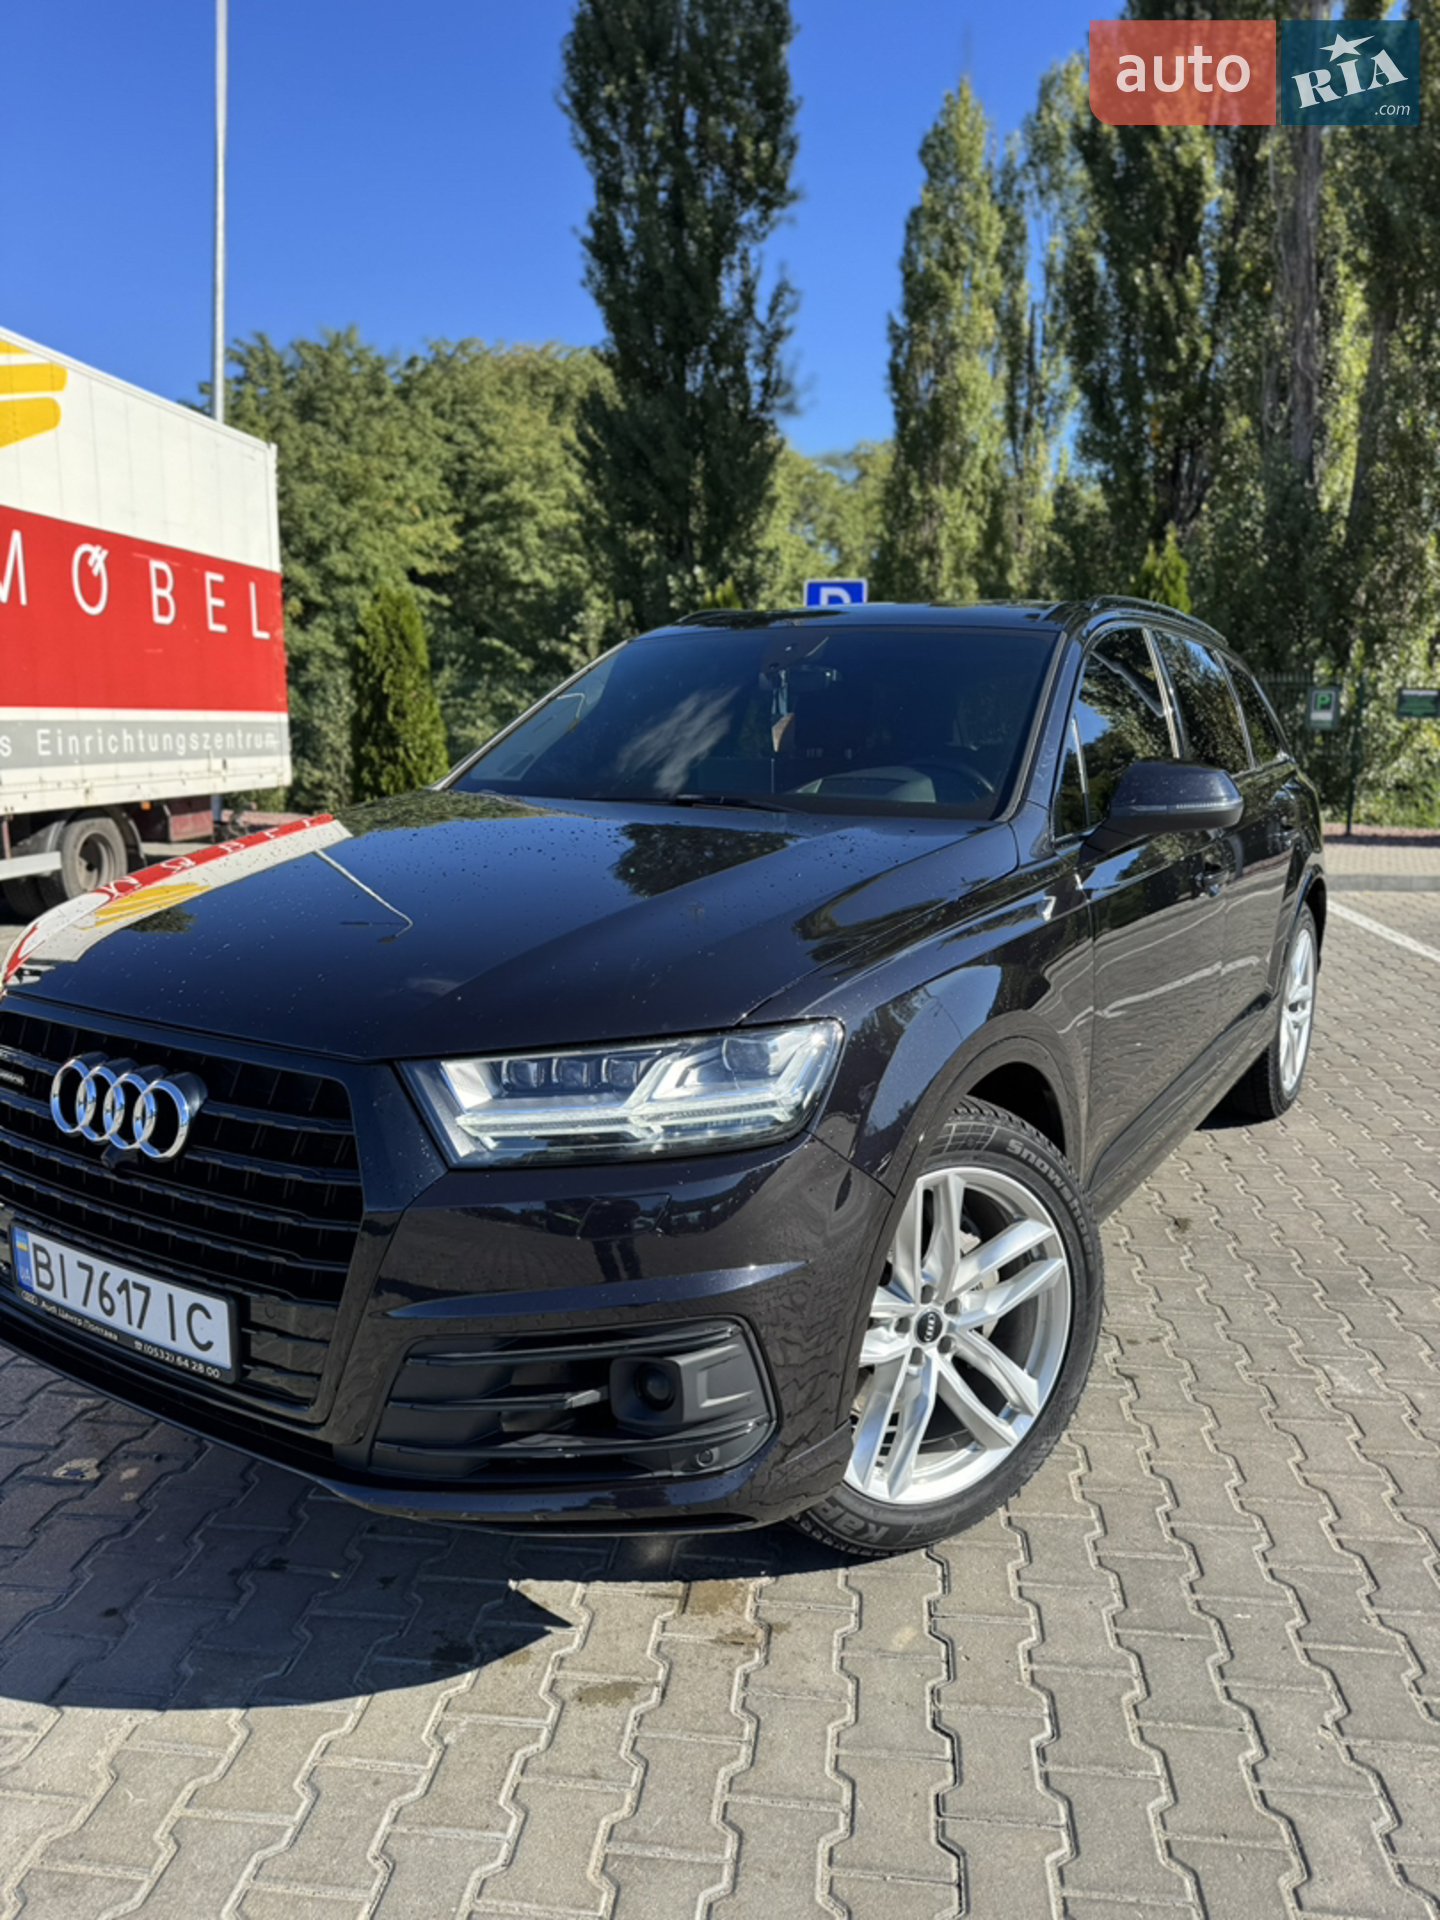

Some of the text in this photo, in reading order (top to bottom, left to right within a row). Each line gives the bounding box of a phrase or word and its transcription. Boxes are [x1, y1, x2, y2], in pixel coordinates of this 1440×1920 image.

[32, 1242, 214, 1352] BI 7617 IC
